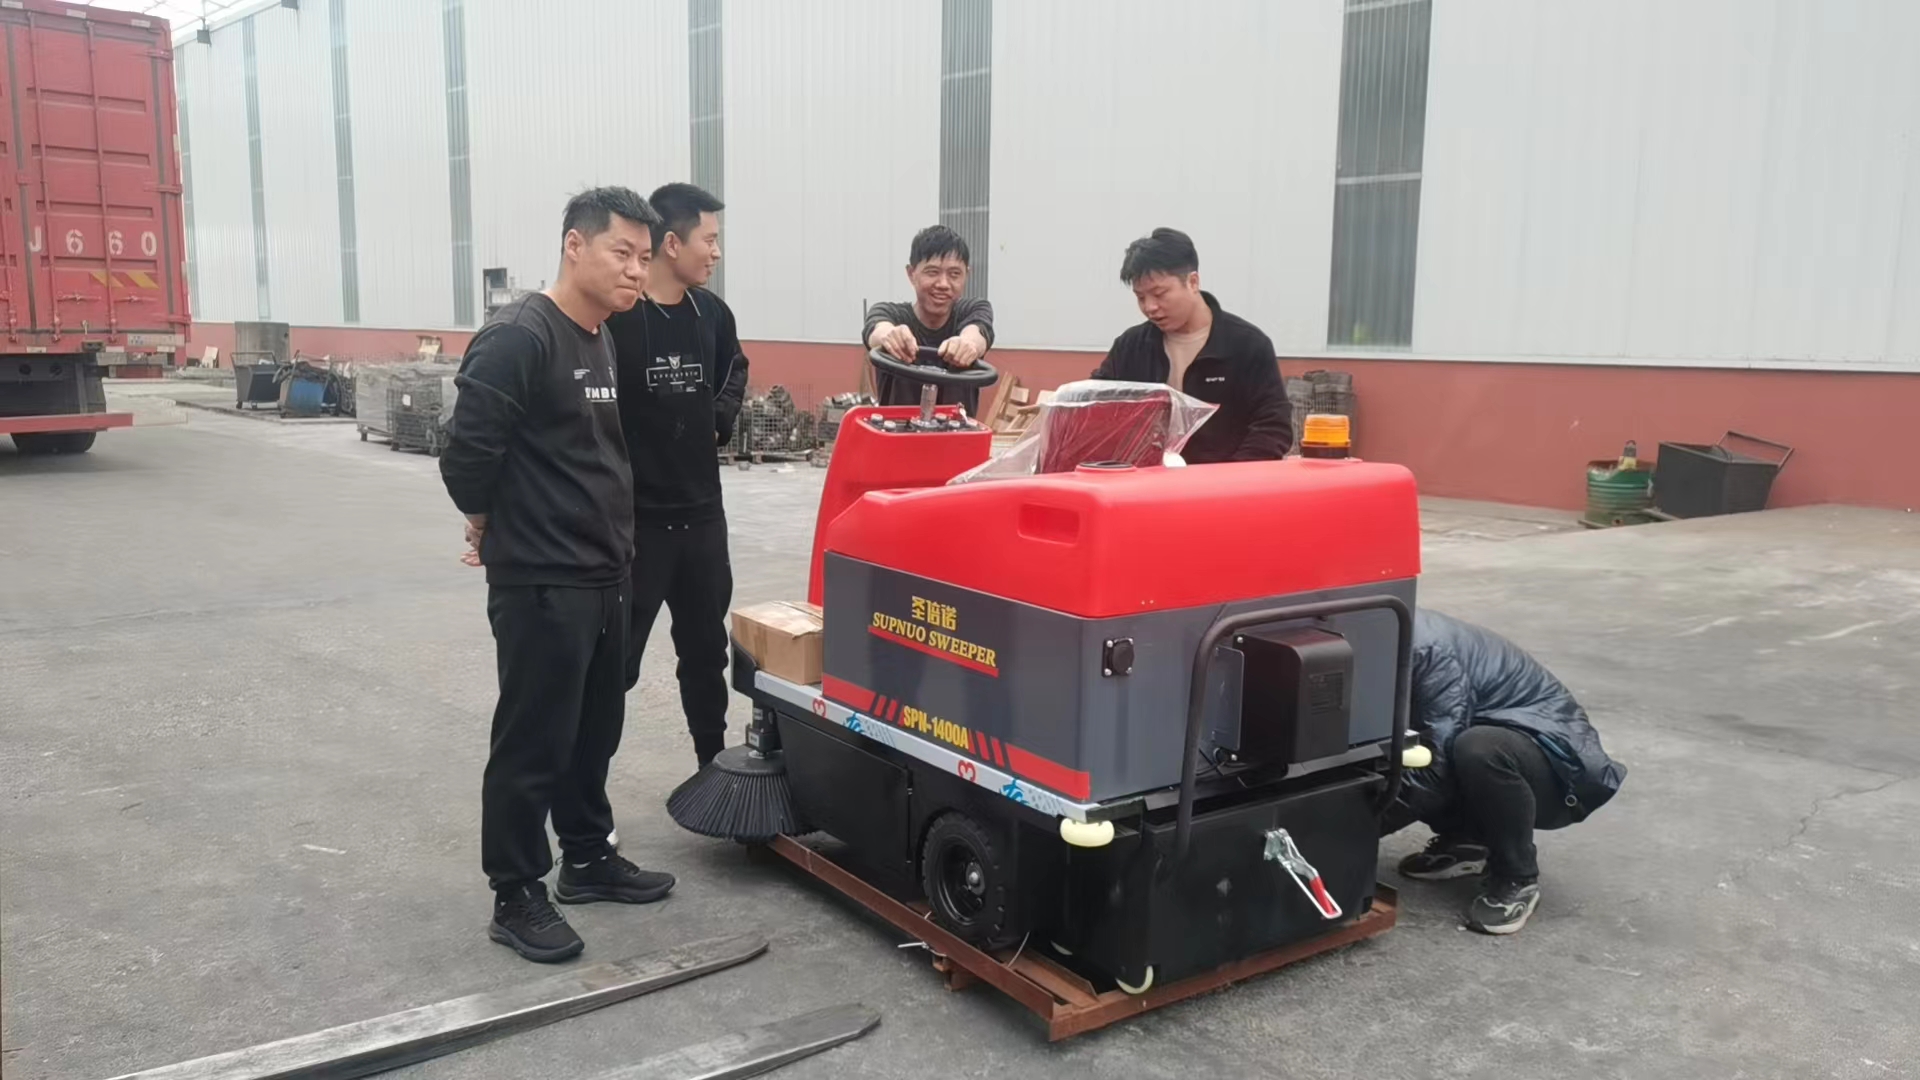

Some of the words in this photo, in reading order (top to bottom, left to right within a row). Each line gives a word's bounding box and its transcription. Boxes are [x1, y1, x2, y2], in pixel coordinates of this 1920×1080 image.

[872, 611, 926, 643] SUPNUO
[928, 630, 997, 668] SWEEPER
[903, 704, 970, 751] SPN-1400A
